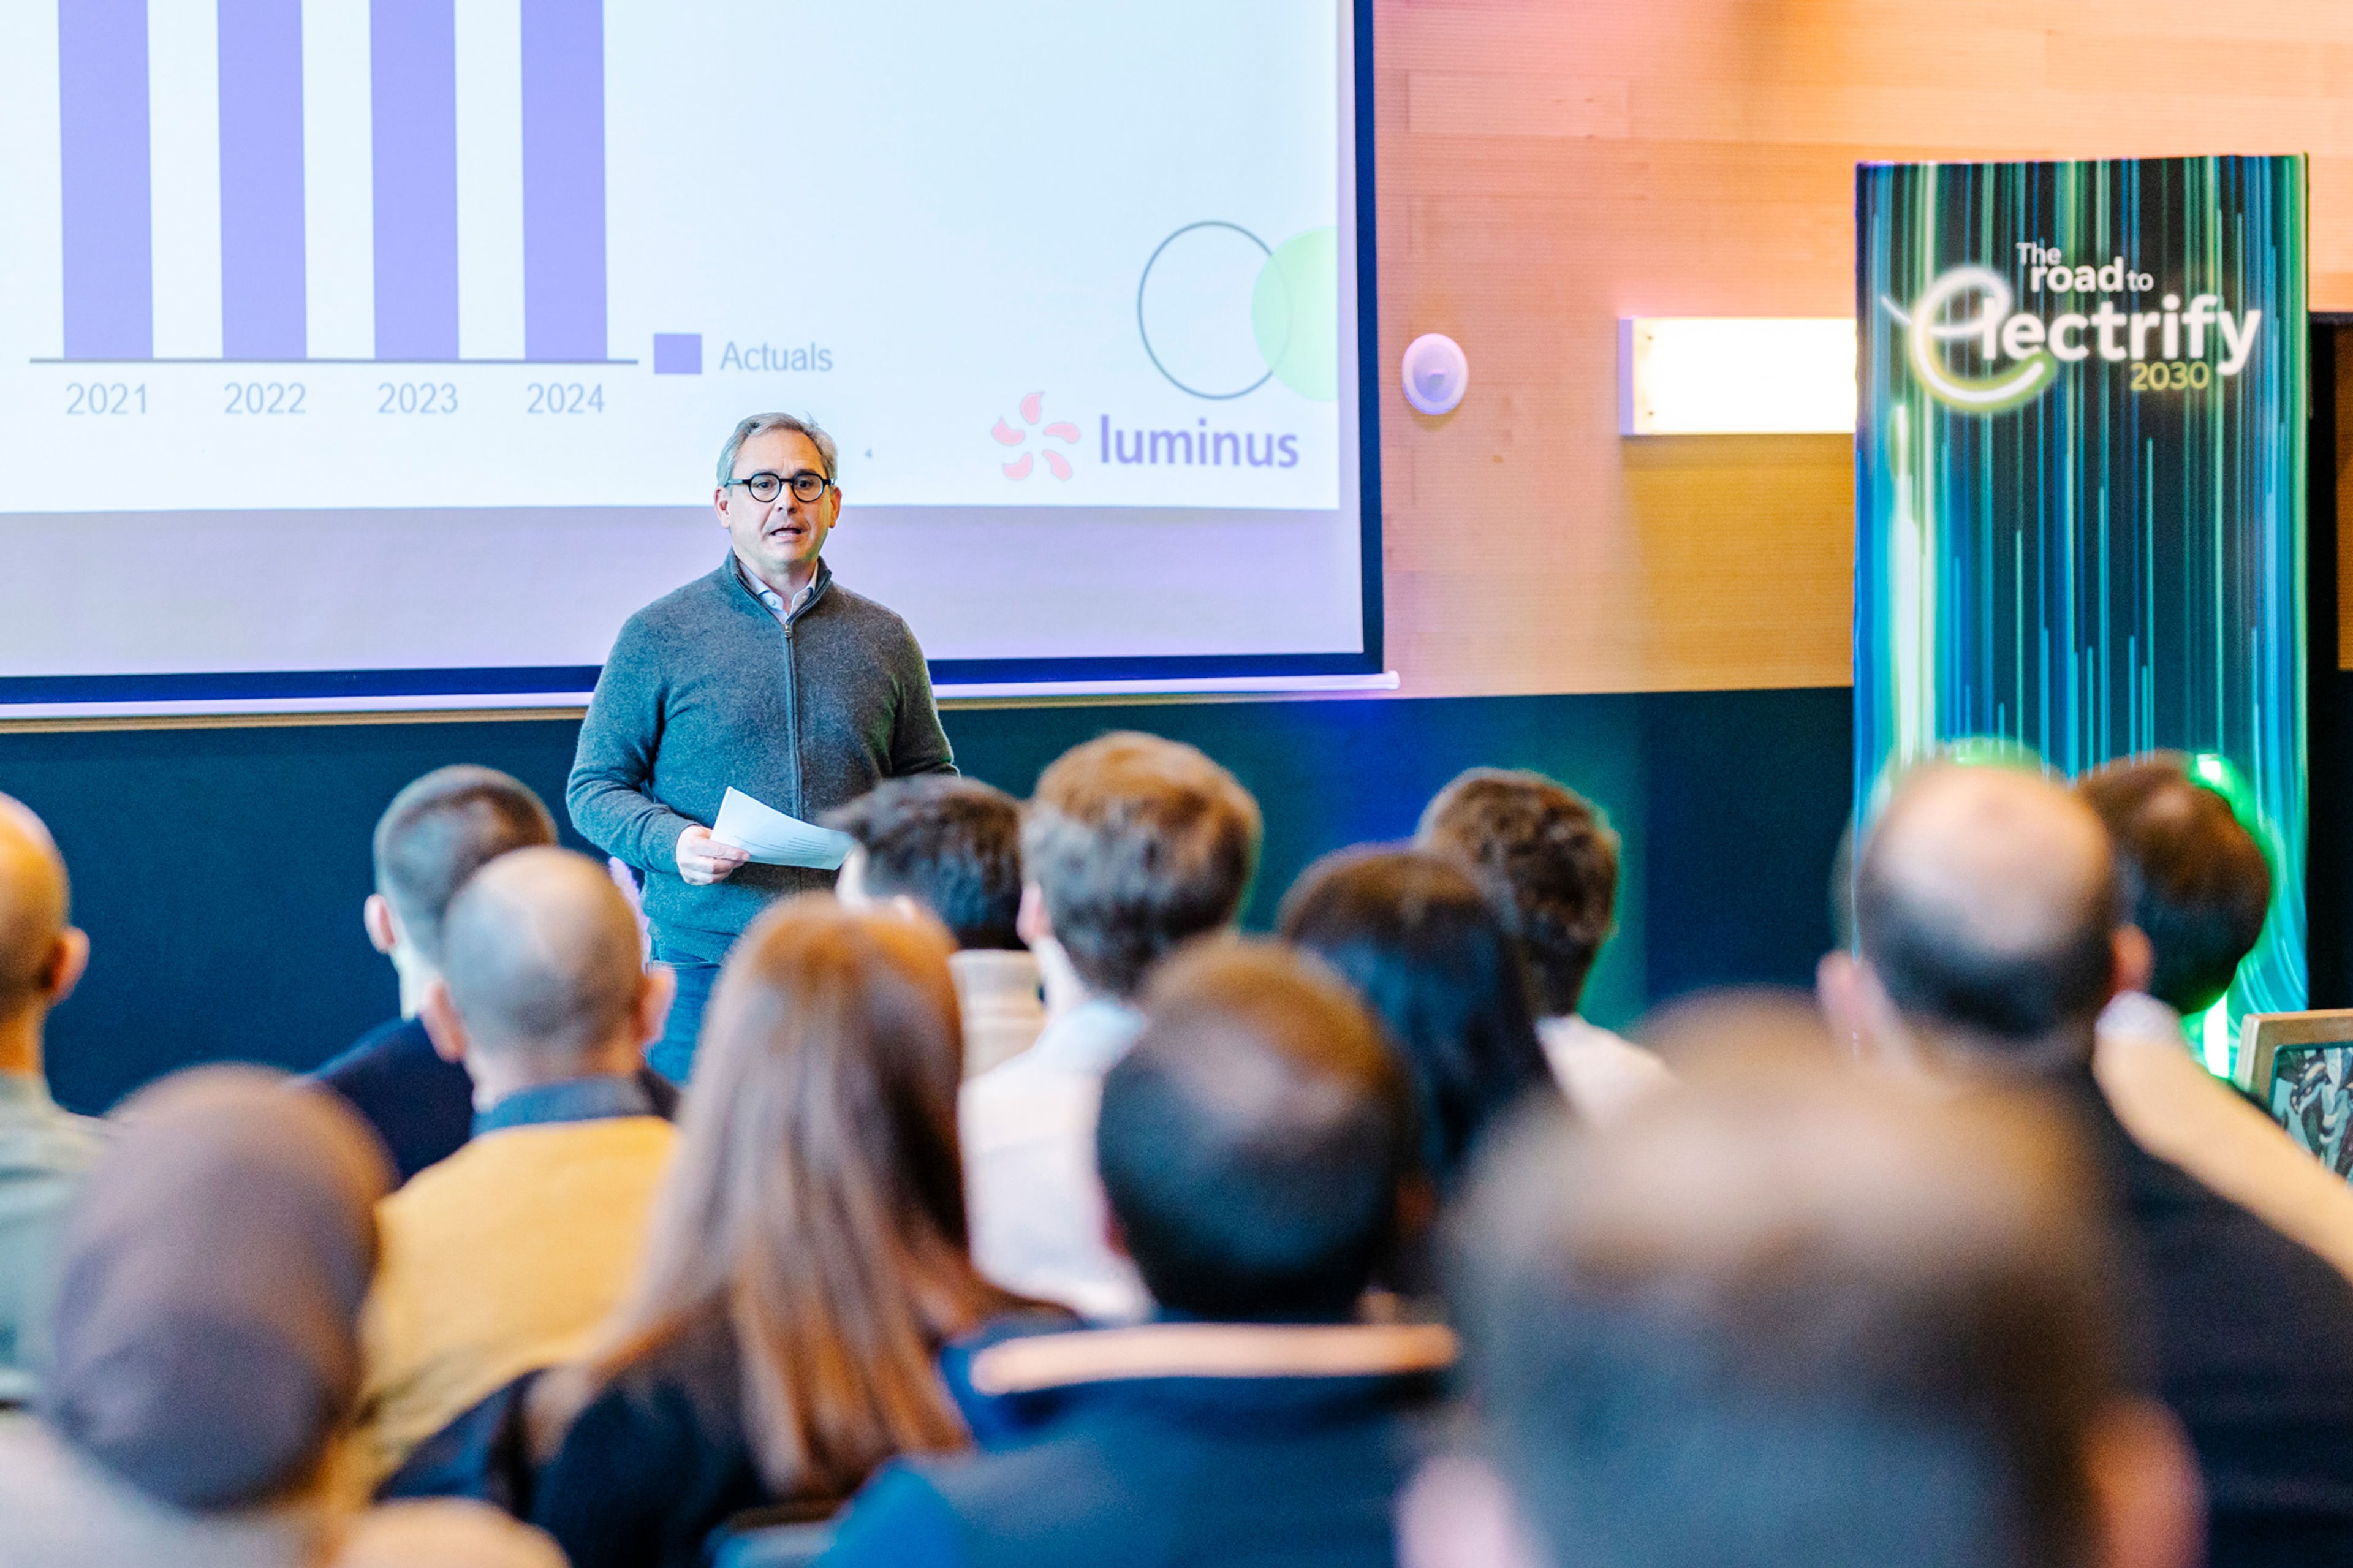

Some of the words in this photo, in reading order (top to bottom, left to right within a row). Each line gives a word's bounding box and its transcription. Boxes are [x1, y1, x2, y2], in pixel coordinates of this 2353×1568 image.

[2016, 242, 2061, 265] The
[2030, 257, 2124, 292] road
[2126, 269, 2154, 291] to
[1881, 264, 2261, 413] electrify
[720, 341, 833, 372] Actuals
[2130, 362, 2210, 391] 2030
[66, 382, 147, 415] 2021
[224, 382, 306, 414] 2022
[377, 382, 458, 414] 2023
[526, 383, 605, 414] 2024
[865, 449, 873, 459] 4
[1100, 414, 1300, 468] luminus
